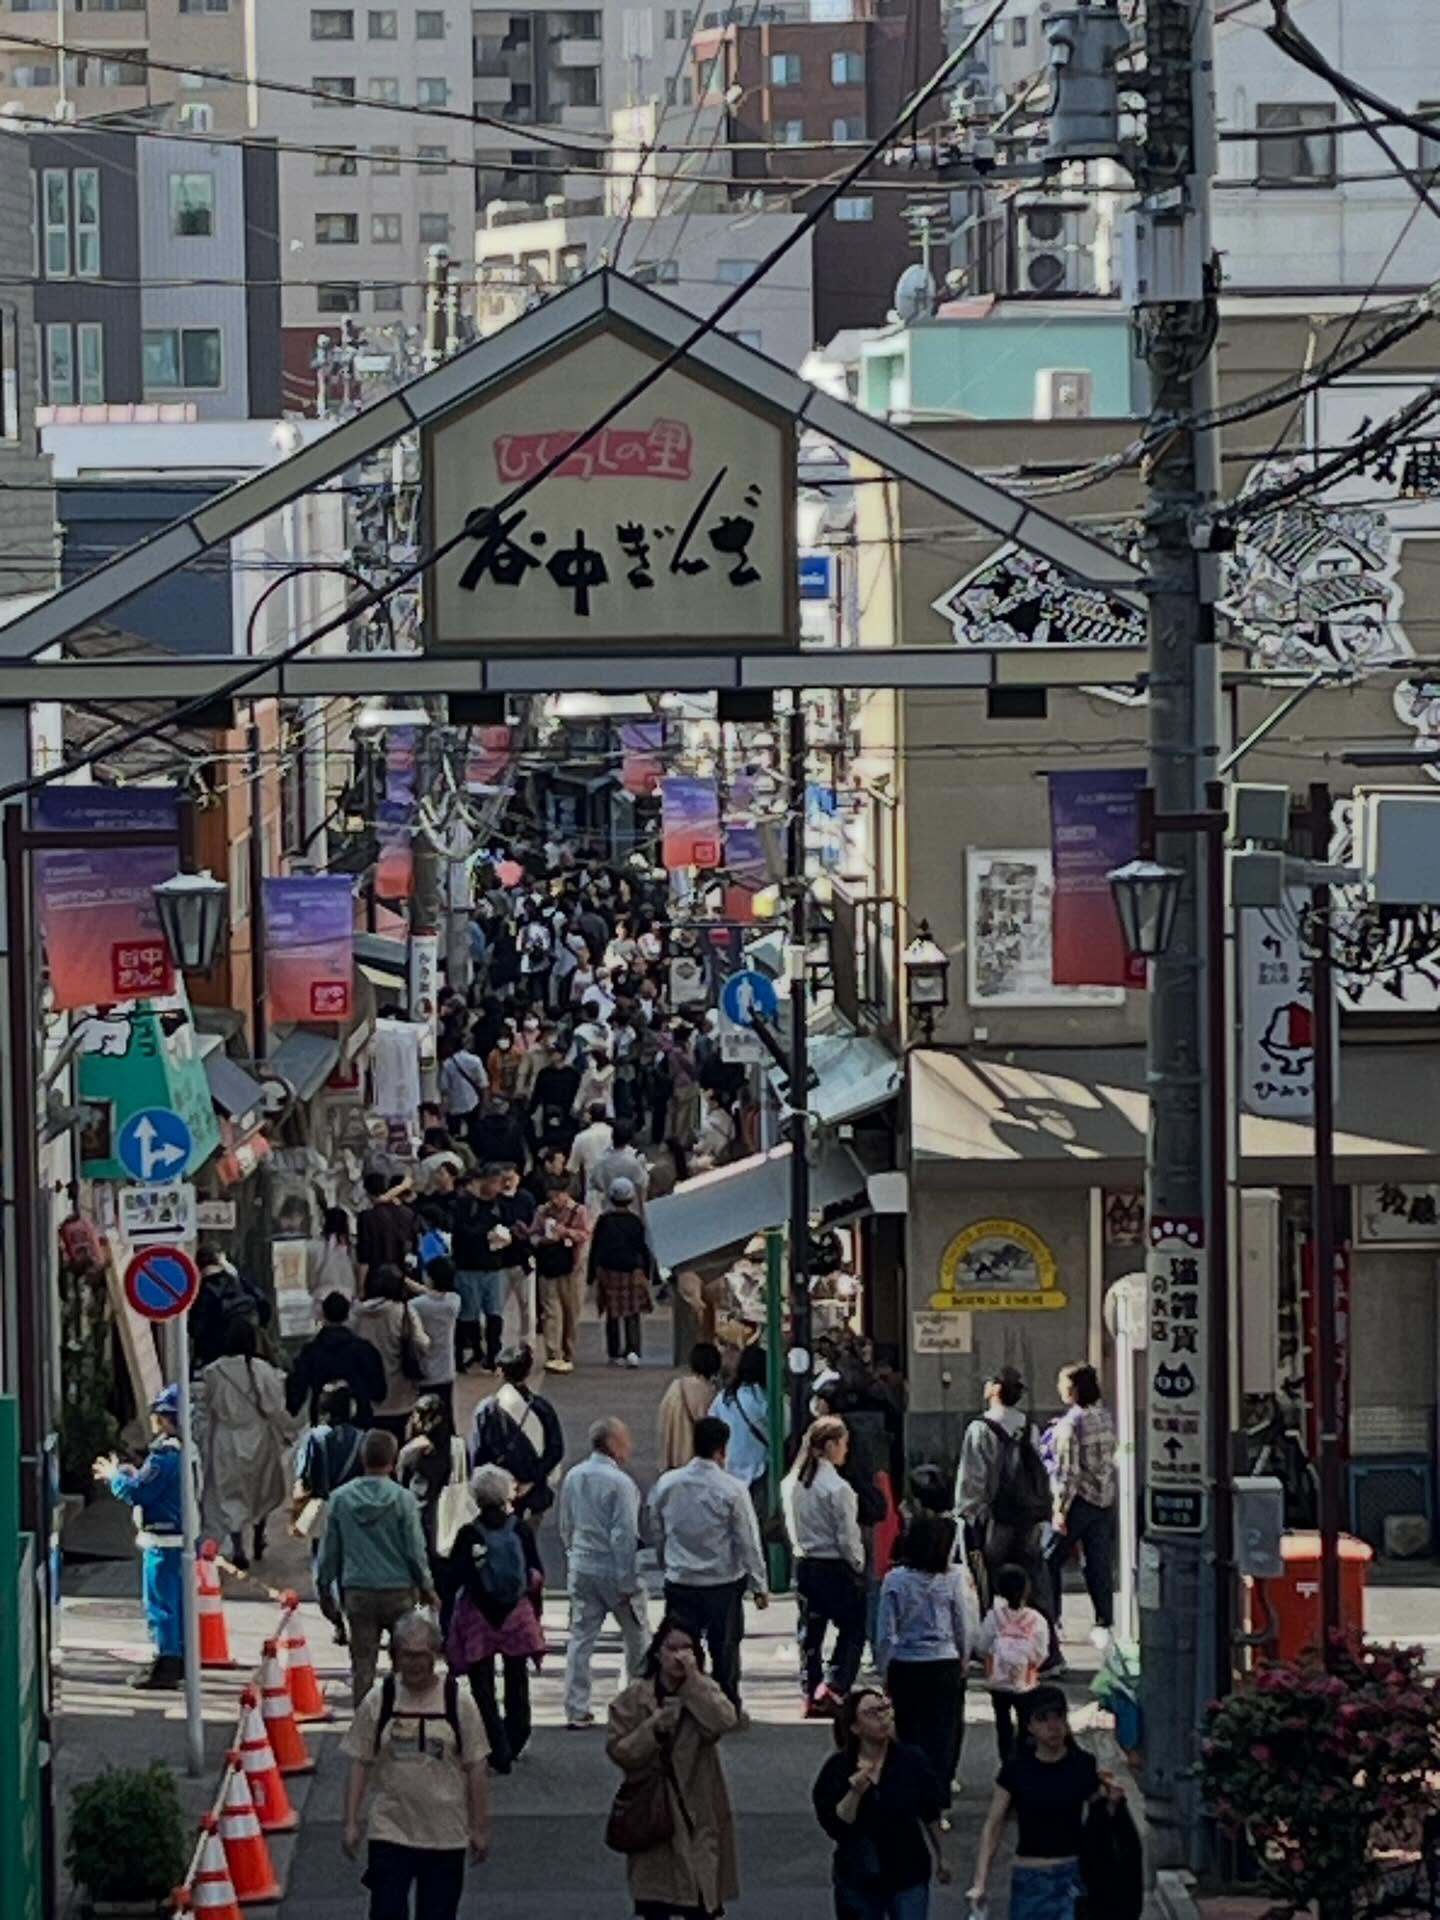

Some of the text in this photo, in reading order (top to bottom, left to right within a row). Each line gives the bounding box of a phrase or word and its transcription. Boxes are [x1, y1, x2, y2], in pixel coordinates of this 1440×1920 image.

[459, 466, 761, 616] 谷中ぎんざ
